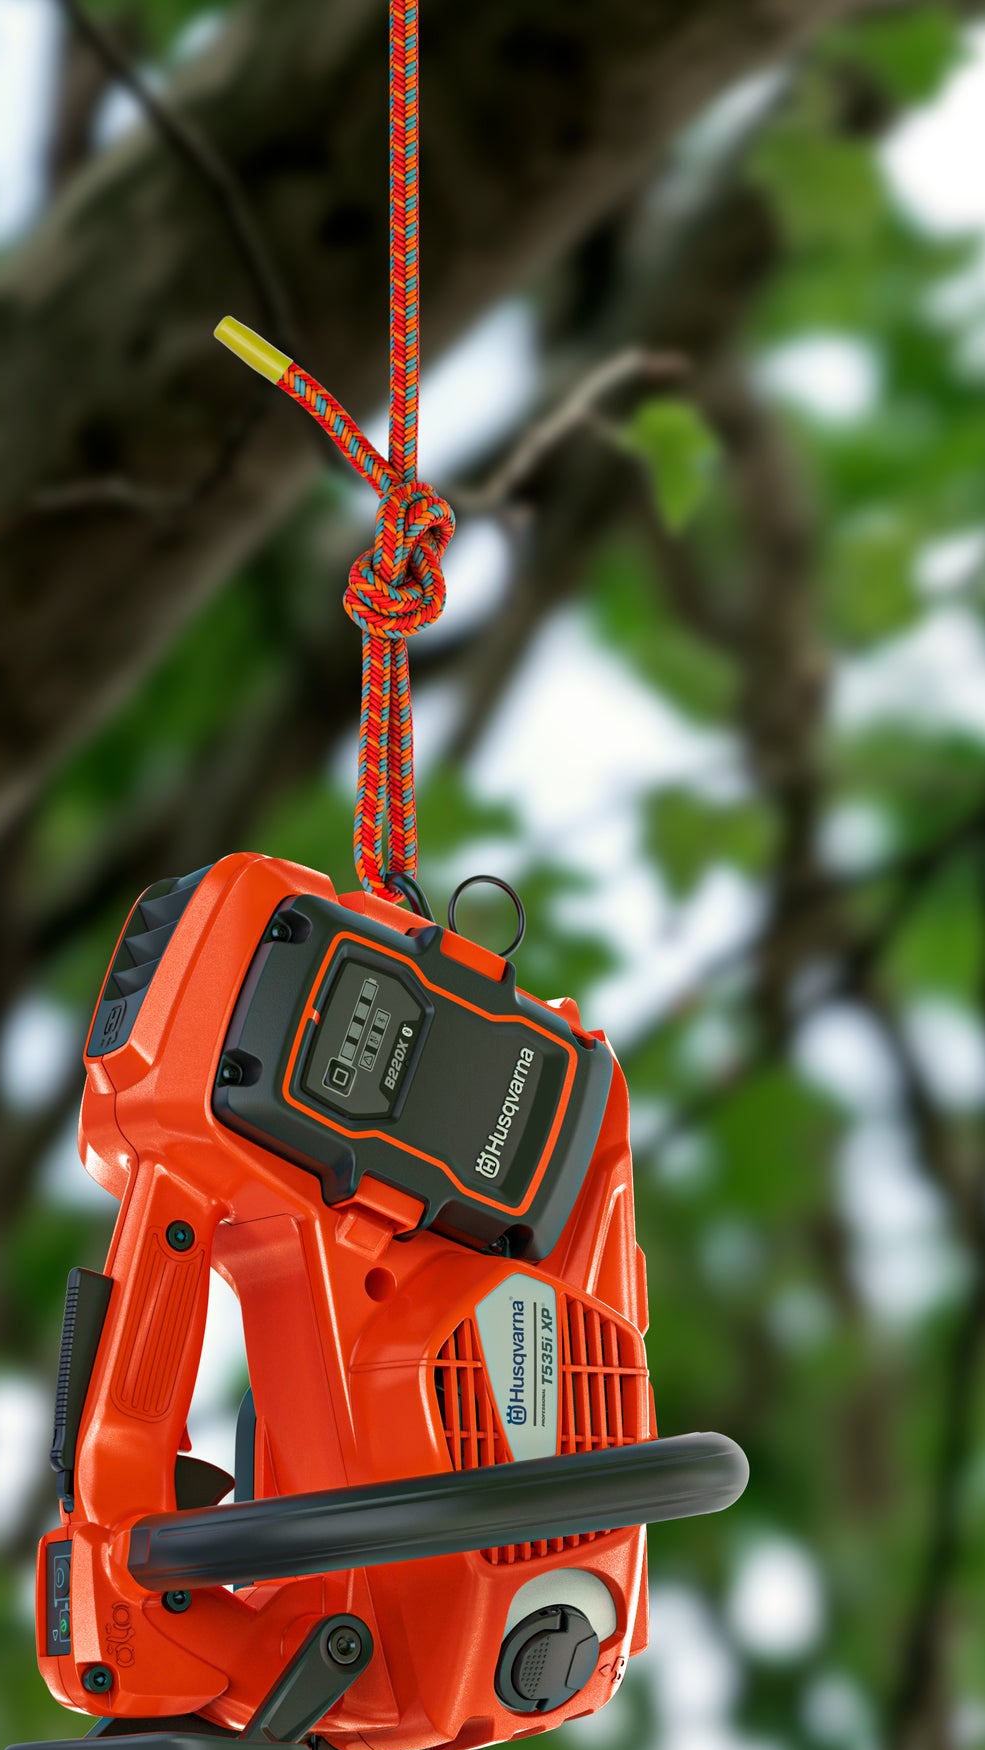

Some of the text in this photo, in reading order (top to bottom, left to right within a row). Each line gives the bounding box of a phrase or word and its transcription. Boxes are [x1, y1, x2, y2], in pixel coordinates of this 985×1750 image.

[383, 1038, 409, 1091] B220X
[484, 1046, 536, 1156] Husqvarna
[541, 1336, 553, 1385] T535i
